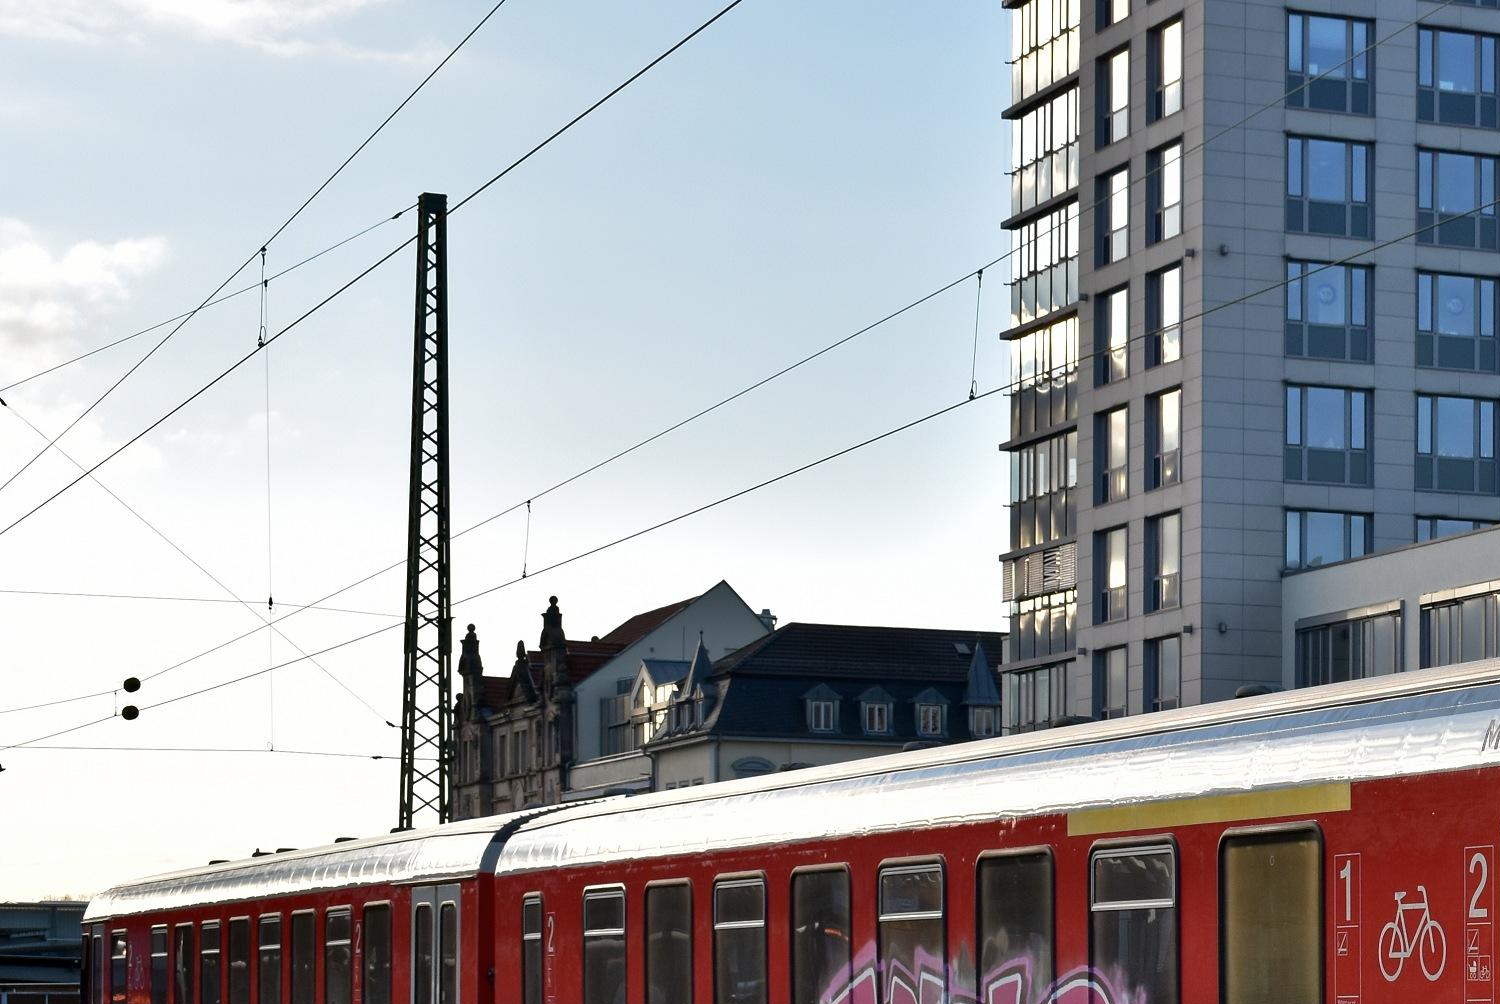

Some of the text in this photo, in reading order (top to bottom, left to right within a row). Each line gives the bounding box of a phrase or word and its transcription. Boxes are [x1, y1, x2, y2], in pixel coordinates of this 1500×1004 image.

[1339, 859, 1352, 922] 1
[1467, 852, 1489, 919] 2
[546, 915, 555, 953] 2
